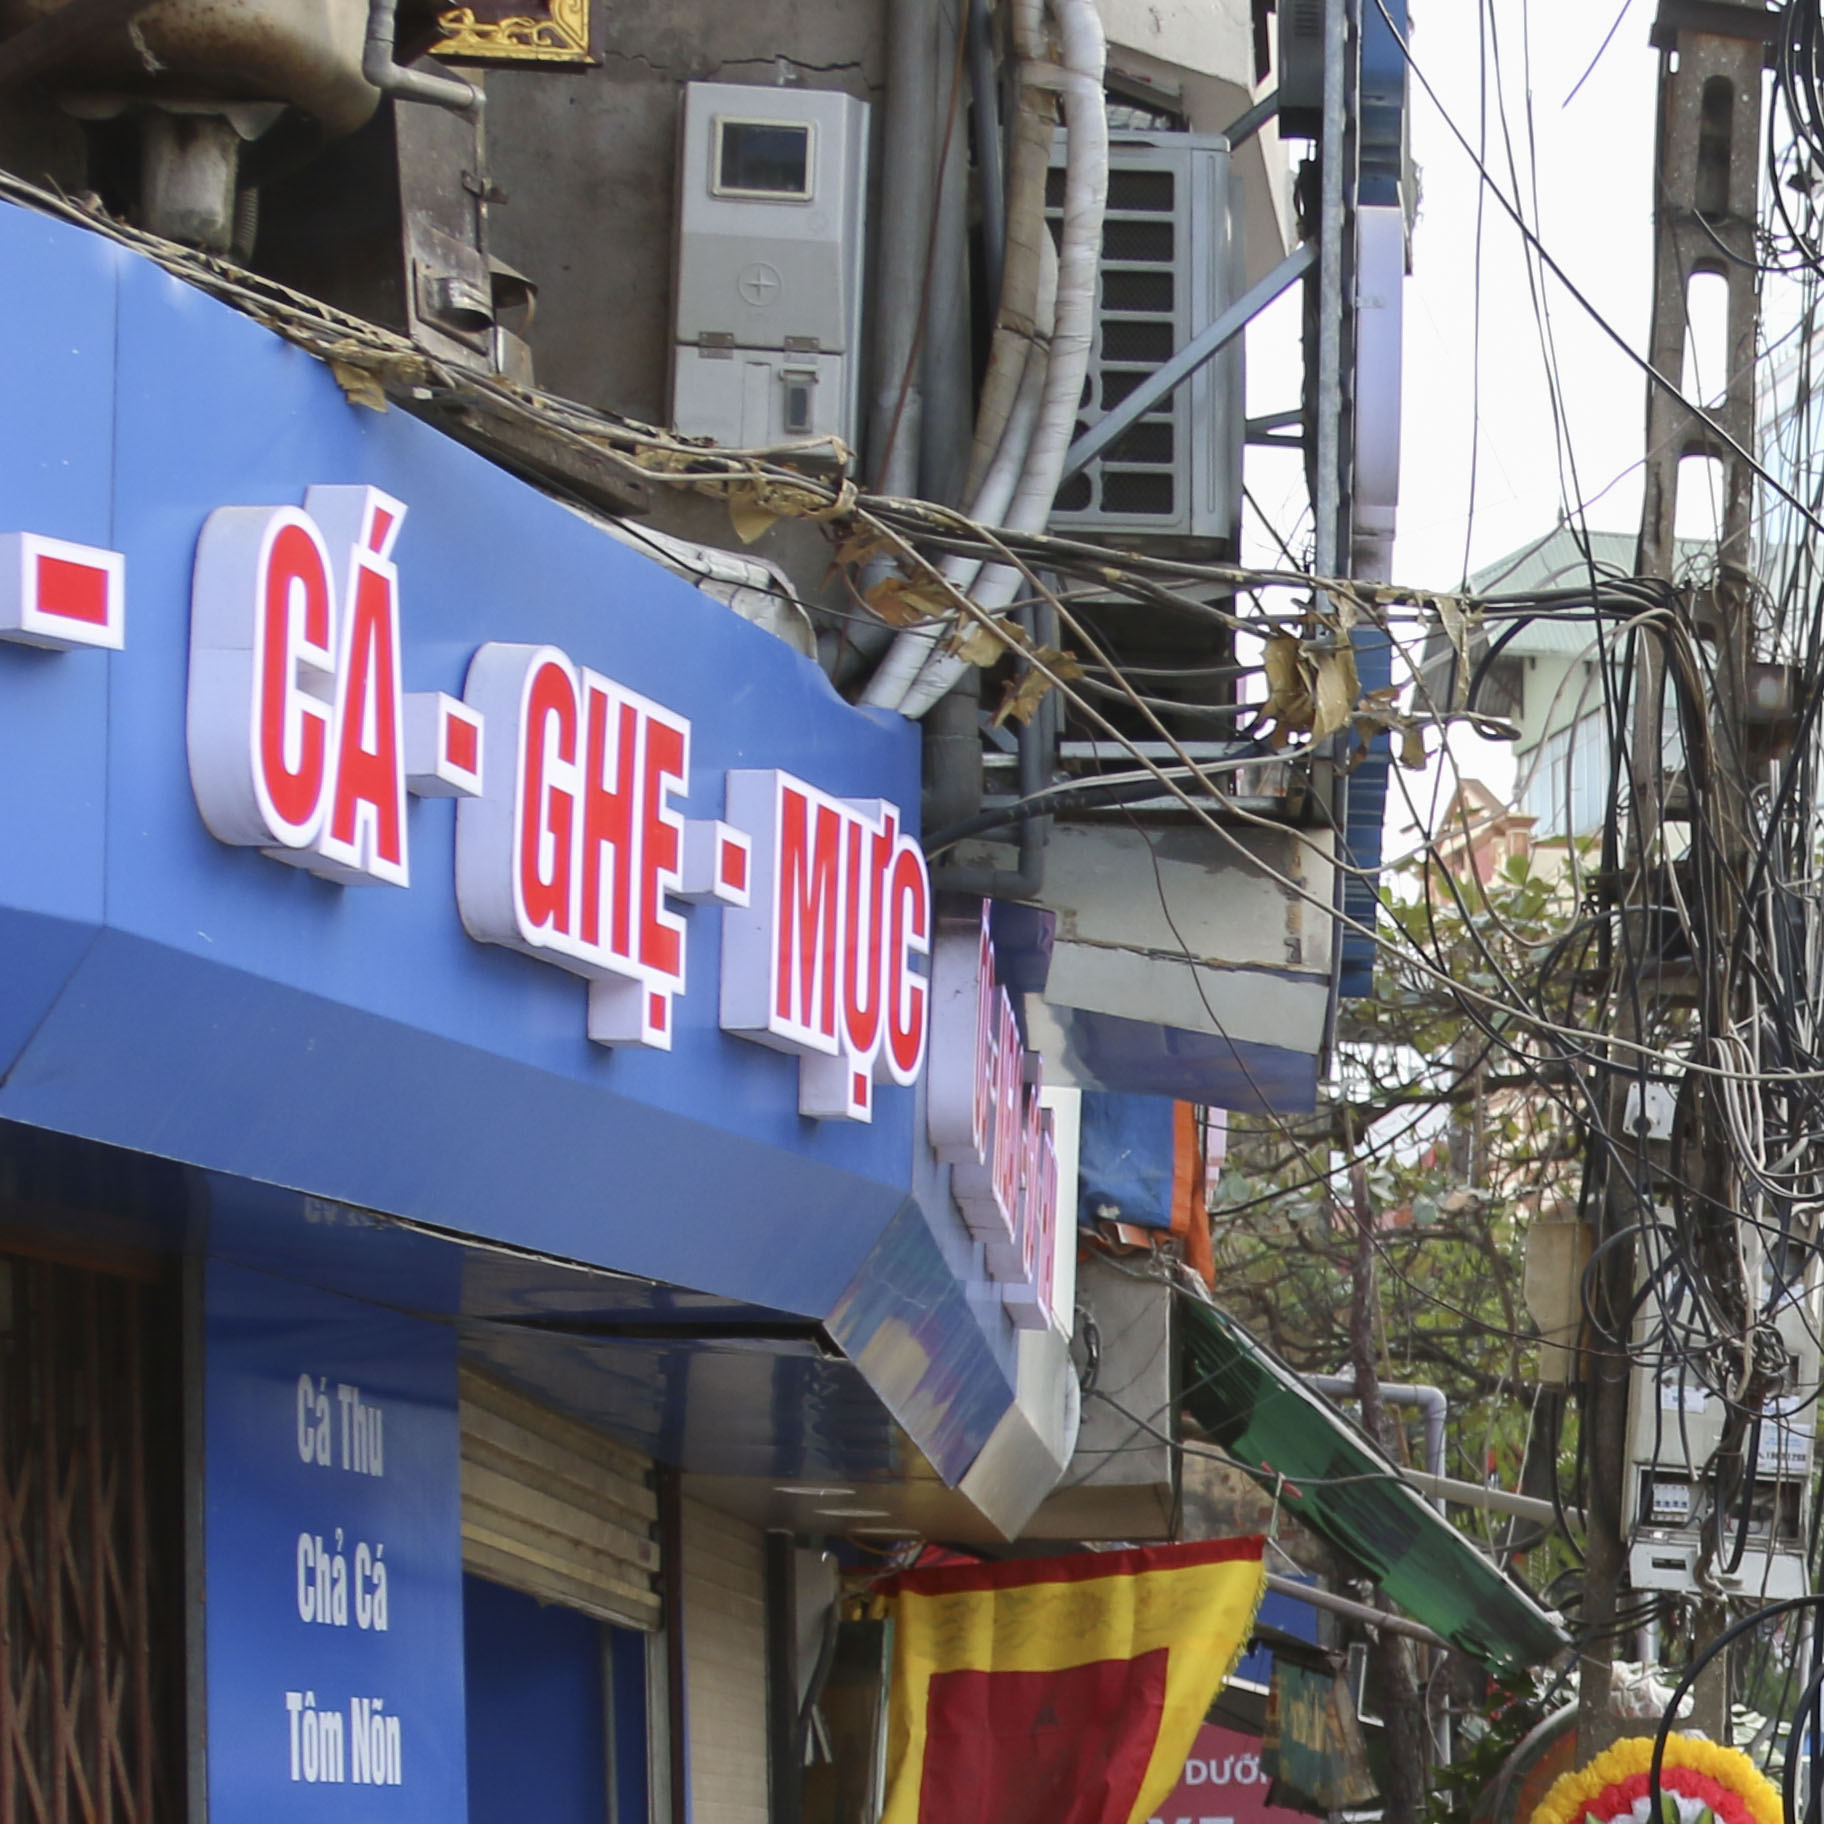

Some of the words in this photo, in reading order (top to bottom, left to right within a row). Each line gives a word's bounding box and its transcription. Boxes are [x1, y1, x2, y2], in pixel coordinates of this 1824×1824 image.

[255, 505, 402, 870] CÁ
[520, 658, 685, 1036] GHẸ
[775, 785, 928, 1112] MỰC
[298, 1374, 331, 1465] Cá
[338, 1383, 383, 1477] Thu
[298, 1528, 347, 1627] Chả
[355, 1543, 388, 1631] Cá
[286, 1691, 344, 1783] Tôm
[351, 1697, 401, 1785] Nõn
